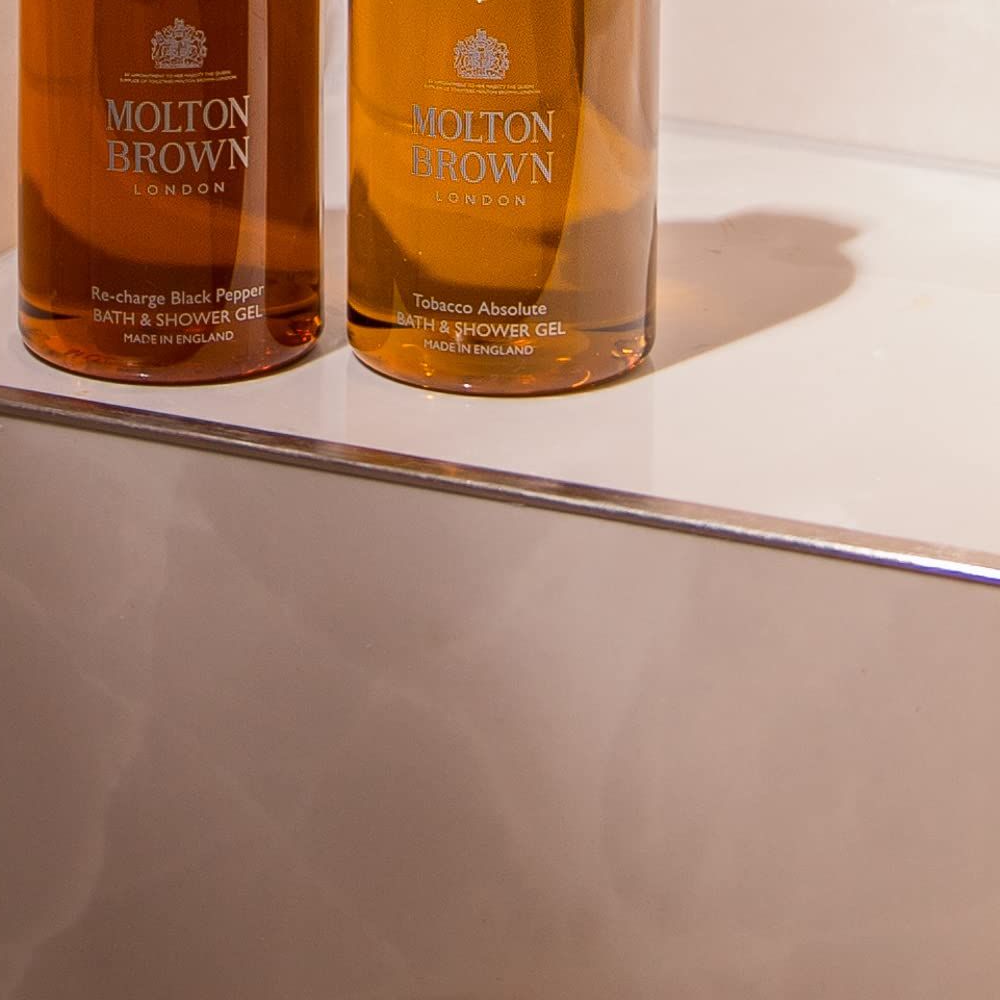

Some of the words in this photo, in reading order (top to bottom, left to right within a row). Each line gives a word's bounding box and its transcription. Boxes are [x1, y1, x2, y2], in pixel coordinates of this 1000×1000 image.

[105, 95, 250, 133] MOLTON
[411, 103, 556, 144] MOLTON
[106, 136, 250, 174] BROWN
[411, 145, 555, 184] BROWN
[134, 181, 225, 196] LONDON
[435, 192, 526, 206] LONDON
[91, 286, 166, 309] Re-charge
[170, 290, 211, 306] Black
[216, 285, 265, 304] Pepper
[412, 292, 473, 314] Tobacco
[477, 301, 548, 317] Absolute
[93, 308, 135, 326] BATH
[139, 313, 151, 327] &
[156, 310, 231, 327] SHOWER
[235, 304, 263, 321] GEL
[396, 311, 435, 332] BATH
[439, 319, 450, 334] &
[455, 321, 530, 338] SHOWER
[535, 321, 566, 337] GEL
[123, 333, 157, 345] MADE
[159, 335, 173, 345] IN
[176, 330, 234, 345] ENGLAND
[424, 339, 456, 353] MADE
[457, 341, 471, 354] IN
[473, 345, 534, 356] ENGLAND
